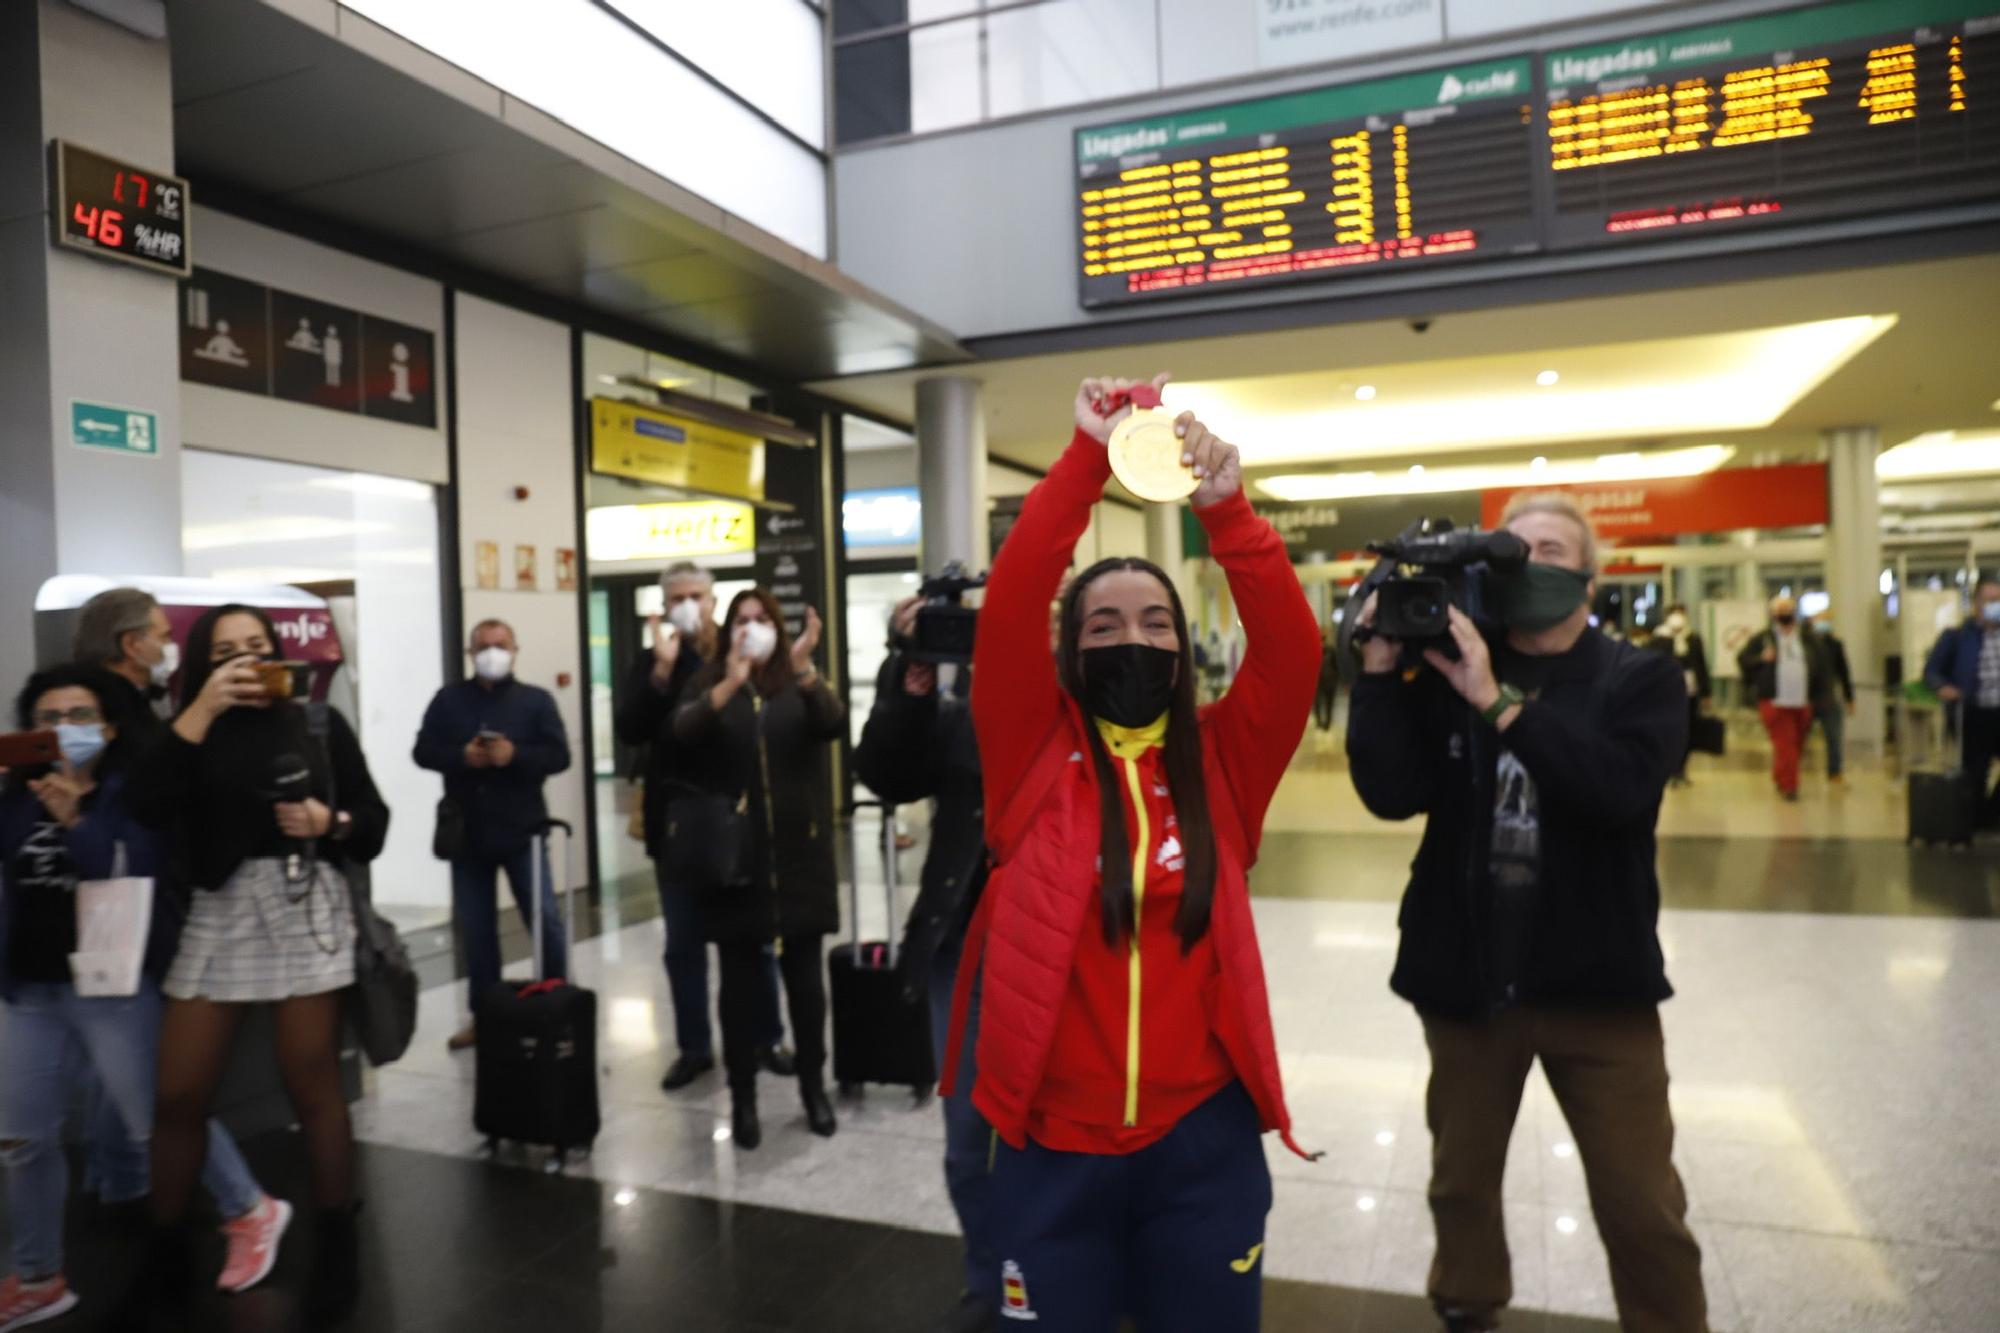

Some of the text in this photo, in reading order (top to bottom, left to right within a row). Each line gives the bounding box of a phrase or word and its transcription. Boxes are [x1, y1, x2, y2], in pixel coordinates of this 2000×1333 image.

[1553, 47, 1658, 83] Llegadas
[112, 171, 148, 209] 17
[74, 202, 124, 248] 46
[650, 508, 742, 543] Hertz
[274, 612, 327, 648] nfe
